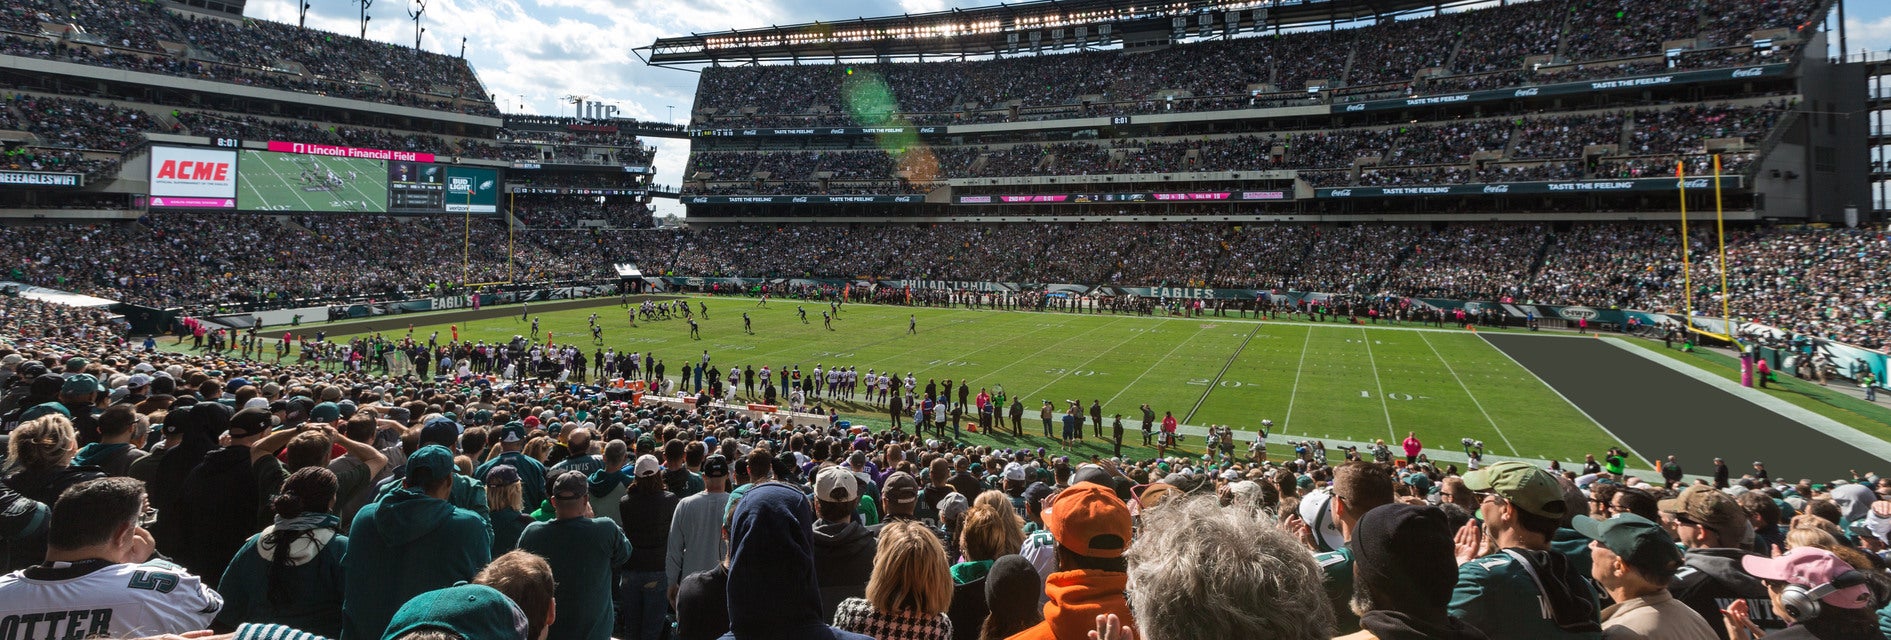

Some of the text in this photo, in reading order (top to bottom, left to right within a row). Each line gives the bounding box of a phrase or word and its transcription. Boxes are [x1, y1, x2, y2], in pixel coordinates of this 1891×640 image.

[1636, 76, 1673, 85] FEELING
[218, 138, 238, 147] 8:01
[308, 145, 415, 162] Lincoln Financial Field
[156, 160, 229, 181] ACME
[1151, 287, 1214, 299] EAGLES
